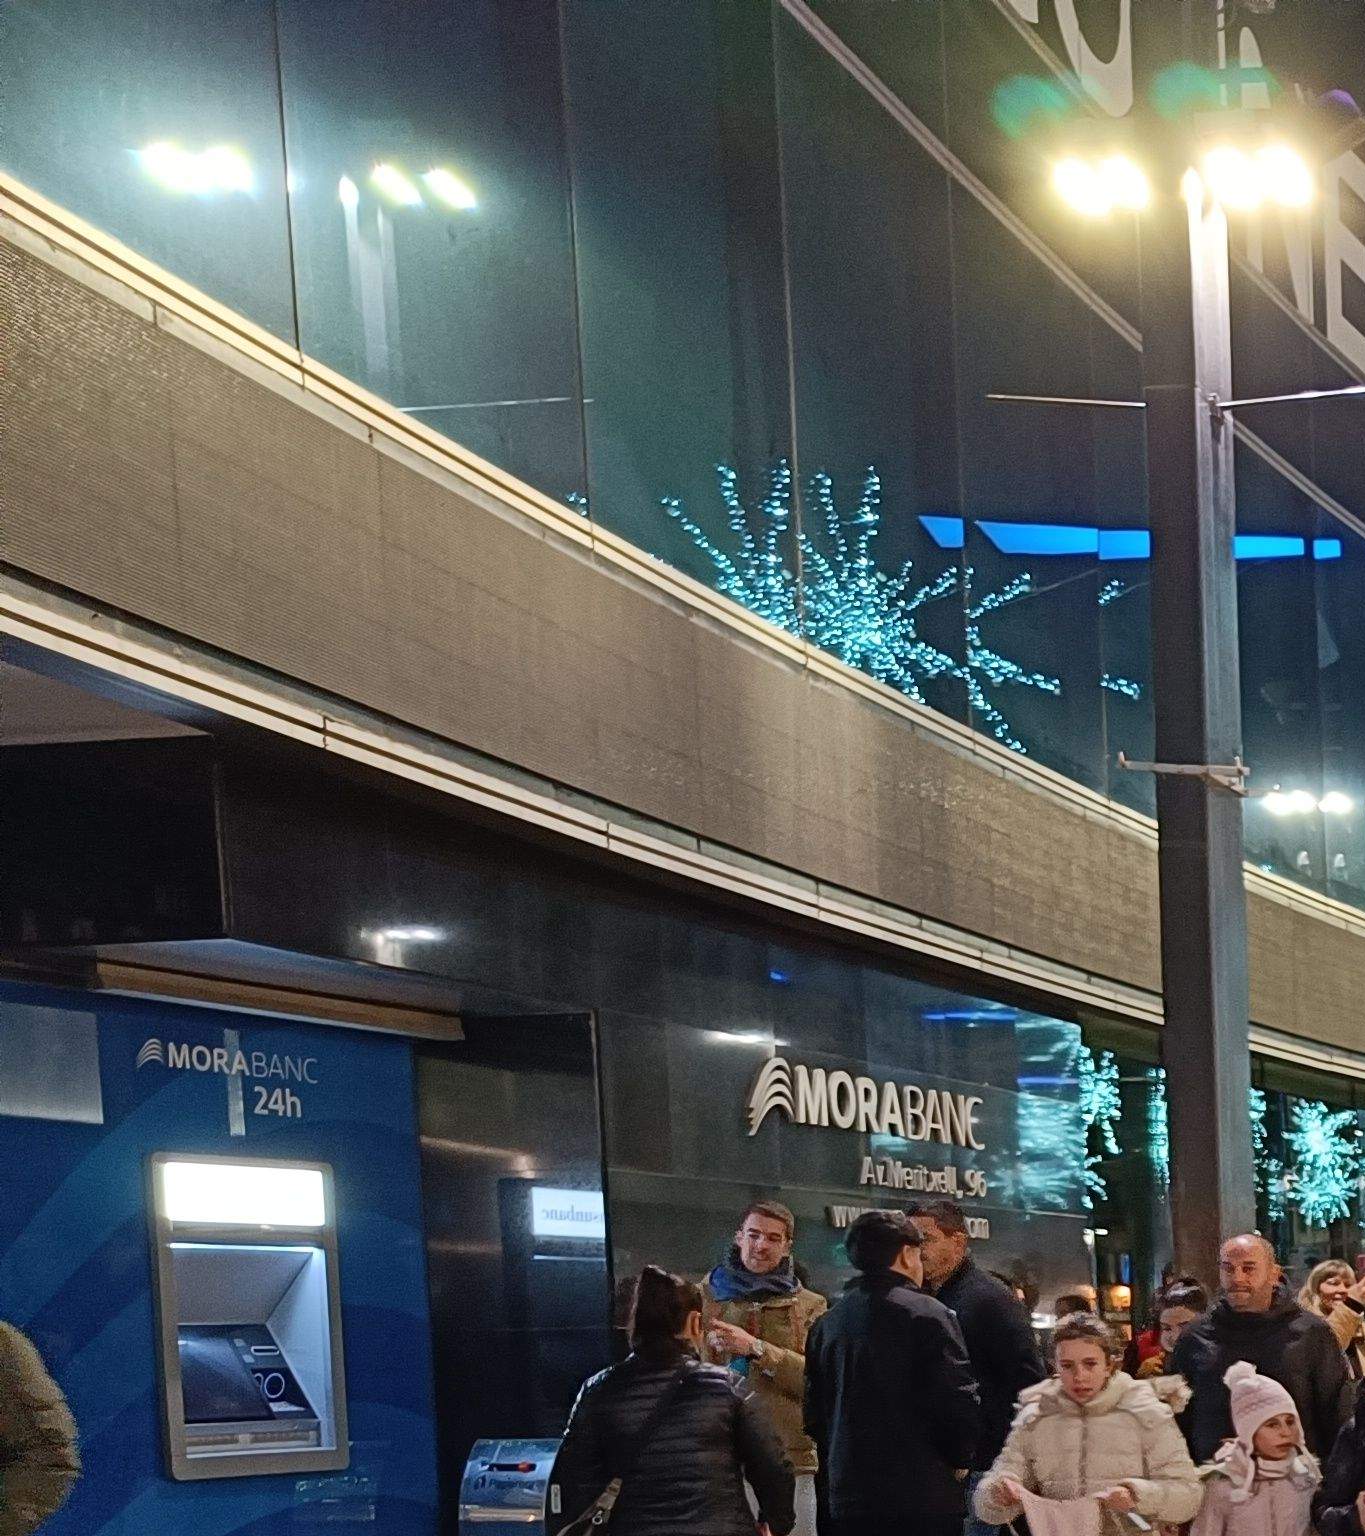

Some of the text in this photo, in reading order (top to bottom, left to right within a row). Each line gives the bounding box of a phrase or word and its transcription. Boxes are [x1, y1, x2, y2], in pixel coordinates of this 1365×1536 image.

[168, 1042, 318, 1084] MORABANC
[254, 1086, 302, 1118] 24h
[793, 1064, 985, 1151] MORABANC
